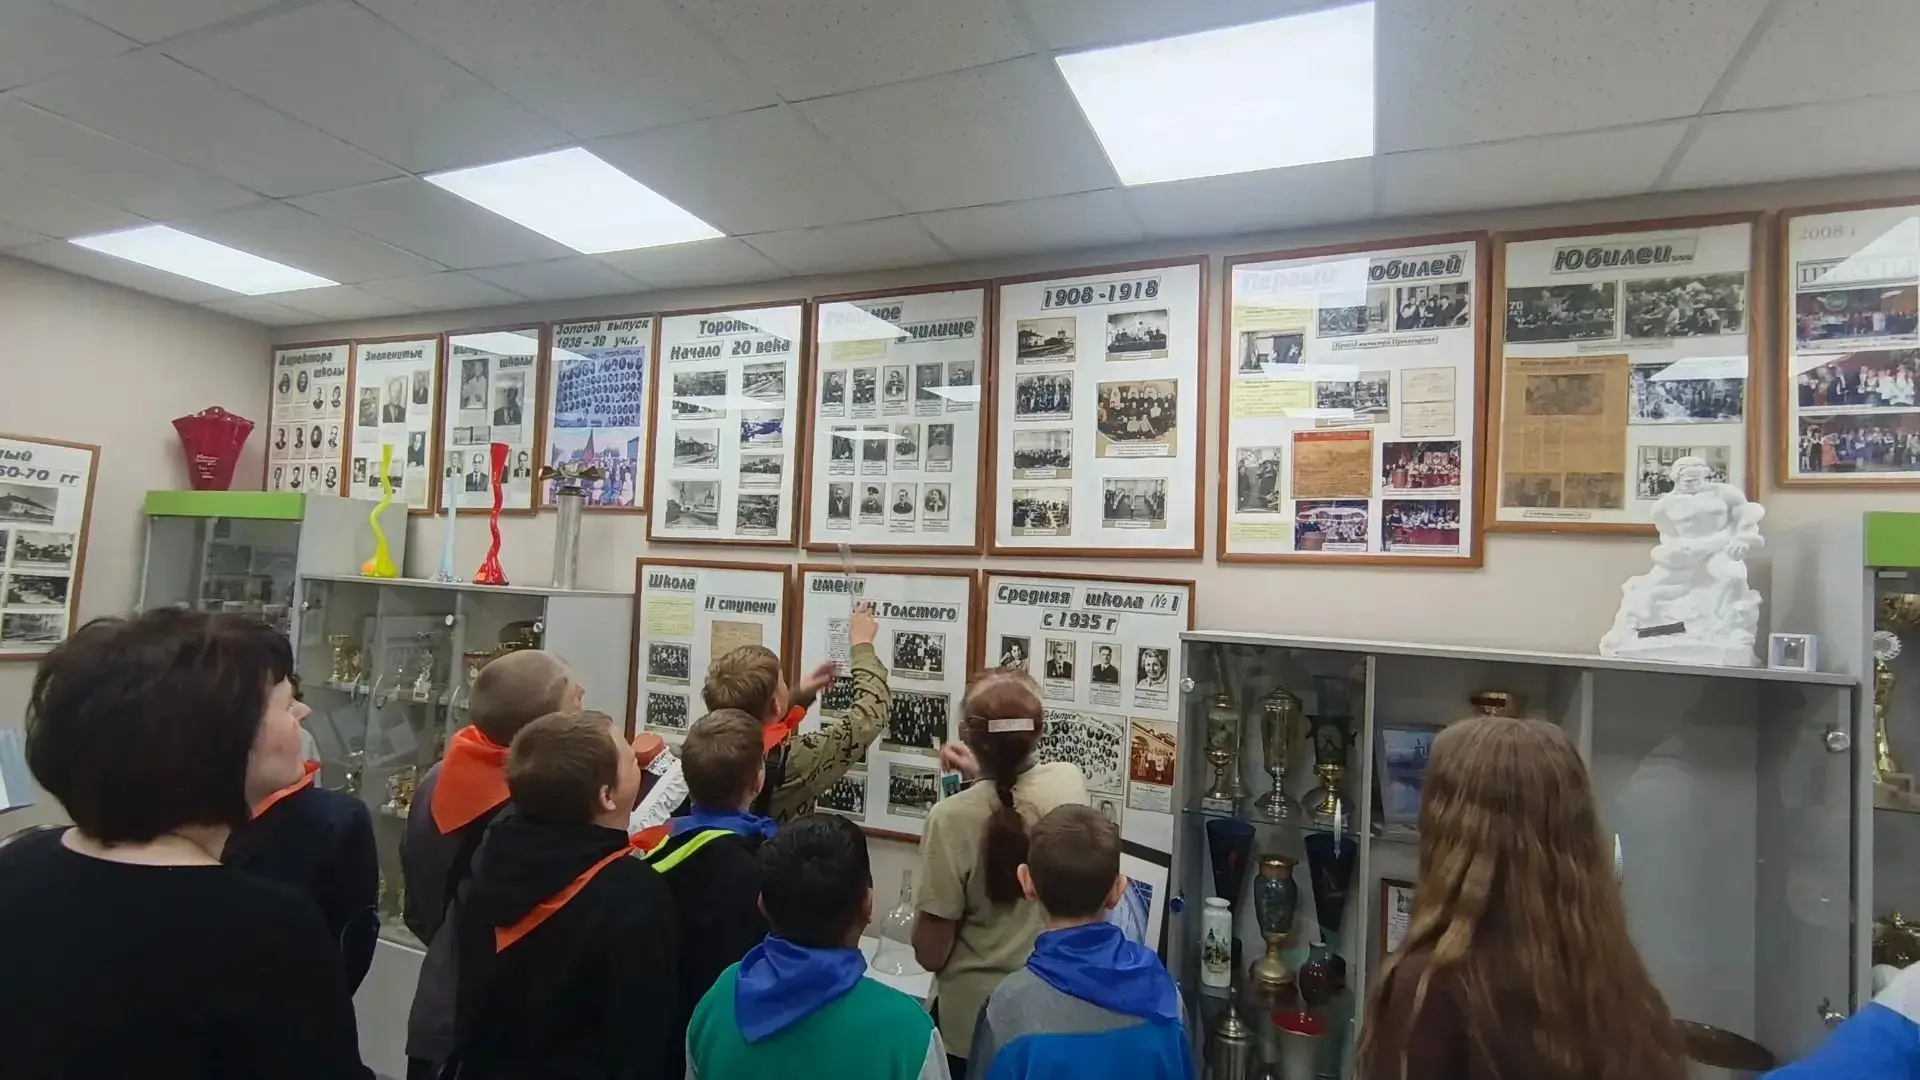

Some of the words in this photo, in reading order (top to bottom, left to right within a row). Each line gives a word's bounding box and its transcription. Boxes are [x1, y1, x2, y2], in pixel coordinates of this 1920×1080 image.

[1044, 280, 1159, 307] 1908-1918
[556, 322, 600, 336] Золотой
[606, 319, 650, 333] выпуск
[365, 349, 424, 362] Знаменитые
[670, 345, 721, 360] Начало
[731, 340, 752, 355] 20
[755, 337, 791, 354] века
[648, 573, 696, 590] Школа
[812, 578, 864, 594] имени
[718, 598, 777, 614] ступени
[997, 585, 1072, 605] Средняя
[1085, 591, 1145, 610] школа
[852, 600, 957, 621] Н.Толстого
[1043, 613, 1053, 627] с
[1059, 612, 1102, 630] 1935
[1106, 617, 1117, 631] г
